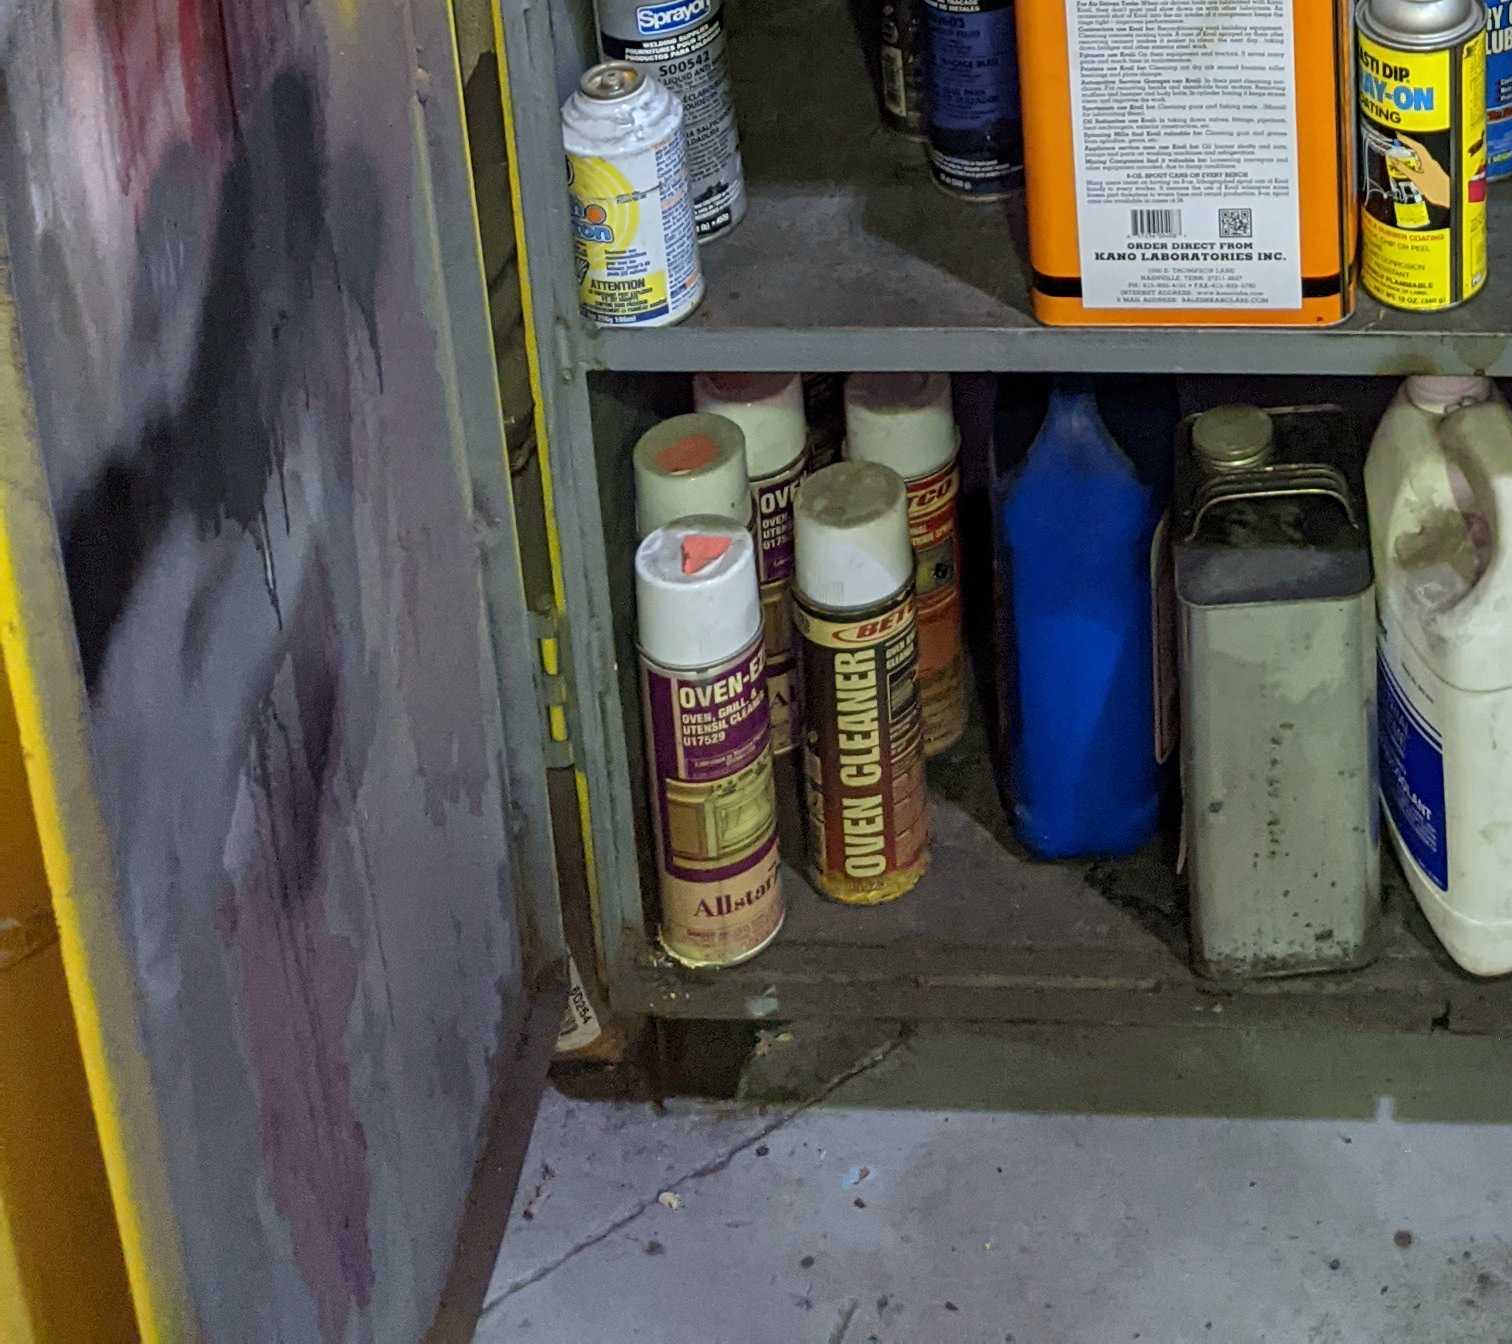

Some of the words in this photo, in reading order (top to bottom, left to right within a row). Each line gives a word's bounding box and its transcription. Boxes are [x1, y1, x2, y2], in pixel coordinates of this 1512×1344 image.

[1127, 242, 1173, 250] ORDER
[1177, 242, 1216, 250] DIRECT
[1219, 242, 1253, 250] FROM
[1095, 252, 1137, 261] KANO
[1141, 252, 1254, 261] LABORATORIES
[1257, 252, 1287, 261] INC.
[591, 277, 646, 290] ATTENTION
[683, 711, 716, 726] OVEN,
[833, 648, 883, 788] CLEANER
[684, 720, 729, 735] UTENSIL
[684, 731, 726, 746] U17529
[843, 792, 887, 880] OVEN
